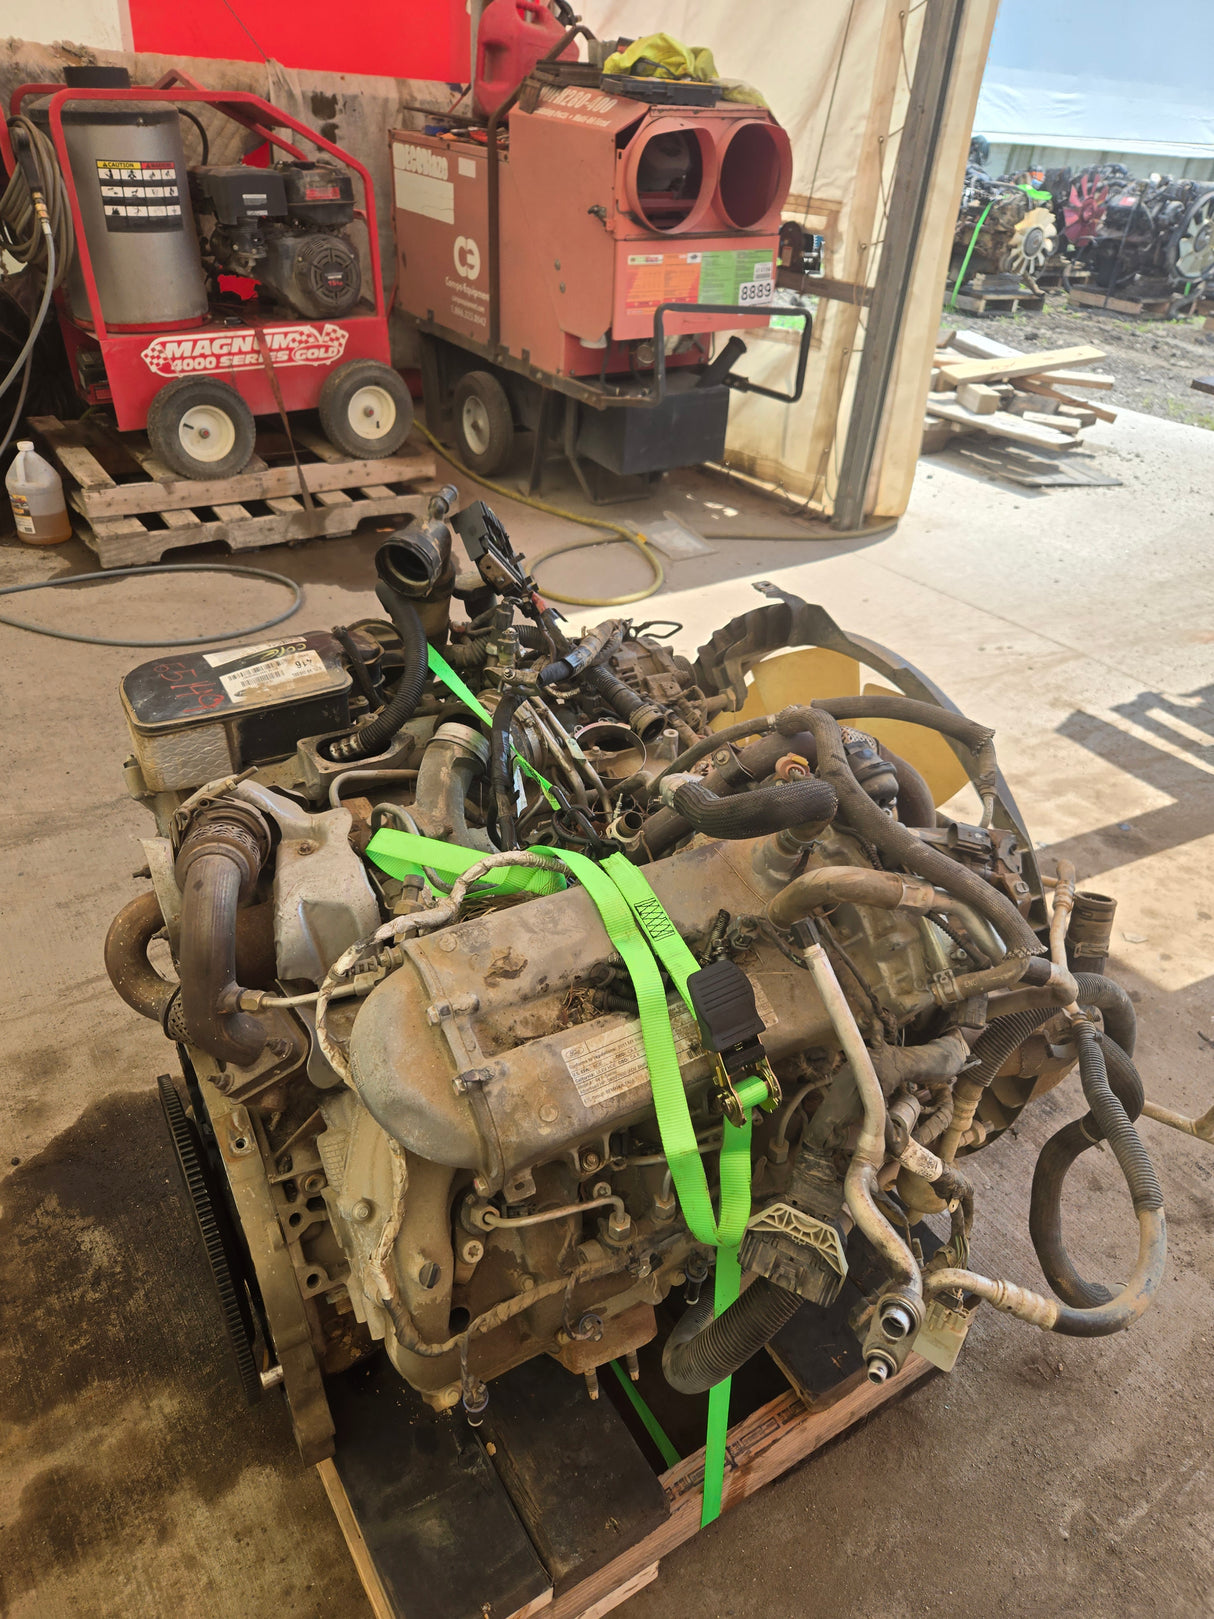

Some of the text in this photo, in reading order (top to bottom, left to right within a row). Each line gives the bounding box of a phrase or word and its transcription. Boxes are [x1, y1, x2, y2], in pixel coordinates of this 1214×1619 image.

[741, 283, 771, 301] 8889
[165, 333, 297, 358] MAGNUM
[172, 357, 216, 372] 4000
[295, 346, 339, 361] GOLD
